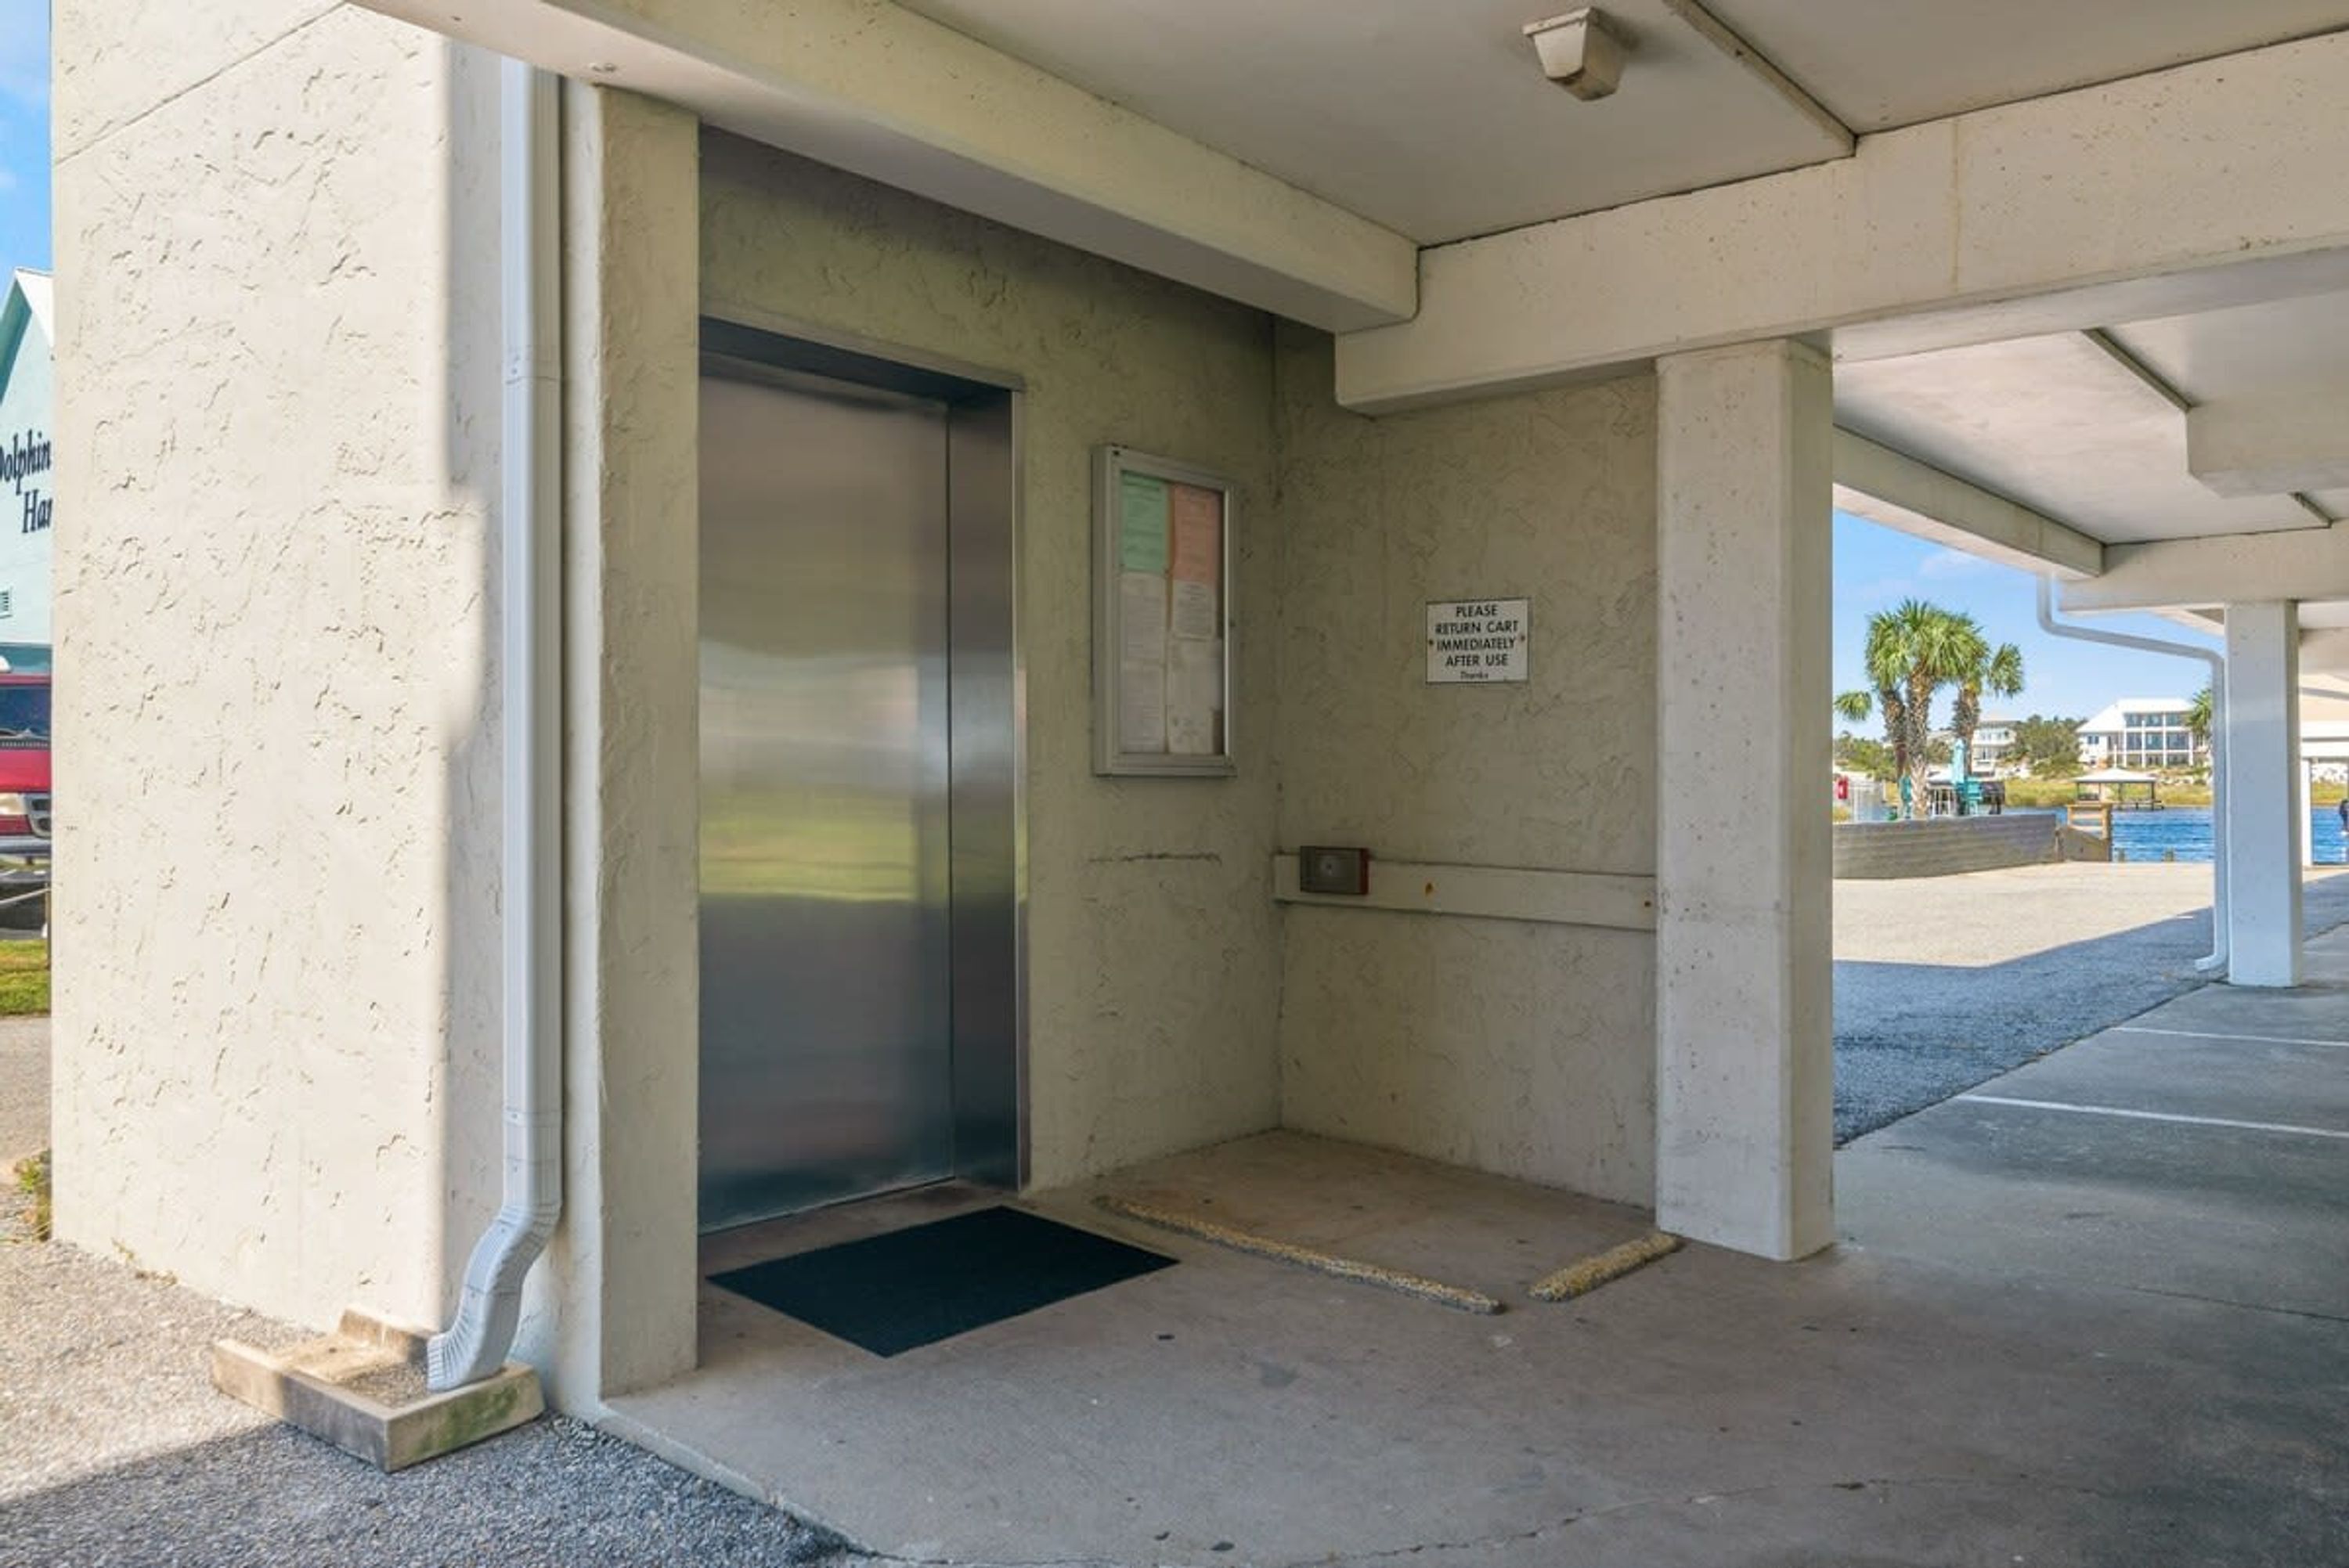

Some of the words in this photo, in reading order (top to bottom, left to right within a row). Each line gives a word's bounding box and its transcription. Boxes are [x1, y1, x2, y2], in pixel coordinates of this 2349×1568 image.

[1456, 604, 1498, 618] PLEASE
[1435, 622, 1481, 635] RETURN
[1487, 620, 1518, 633] CART
[1437, 637, 1516, 651] IMMEDIATELY
[1445, 655, 1480, 667] AFTER
[1485, 654, 1508, 666] USE
